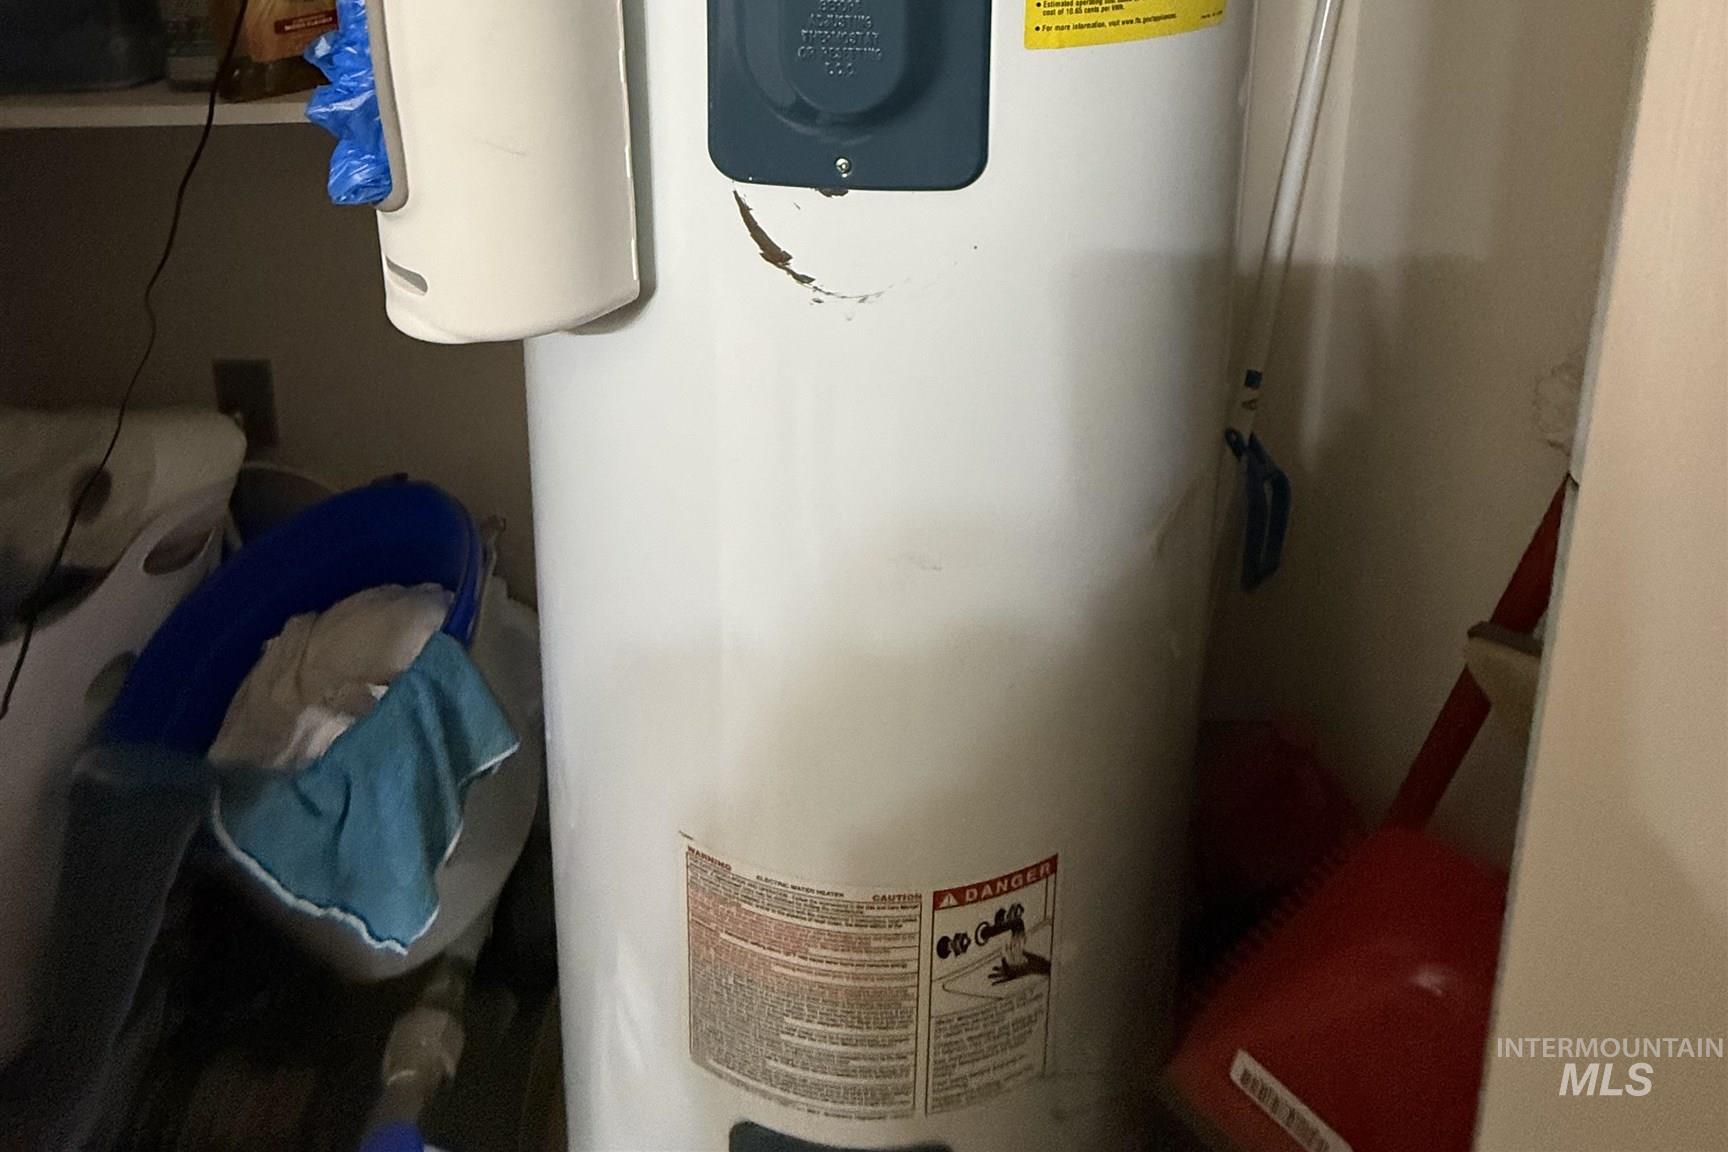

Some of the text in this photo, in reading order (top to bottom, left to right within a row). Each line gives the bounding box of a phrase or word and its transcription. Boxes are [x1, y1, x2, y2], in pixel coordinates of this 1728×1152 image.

[1043, 0, 1074, 8] Estimated
[1084, 6, 1099, 14] cents
[1101, 6, 1111, 14] per
[1042, 24, 1053, 32] For
[688, 845, 732, 871] WARNING
[965, 862, 1050, 902] DANGER
[791, 883, 815, 894] WATER
[872, 893, 922, 902] CAUTION
